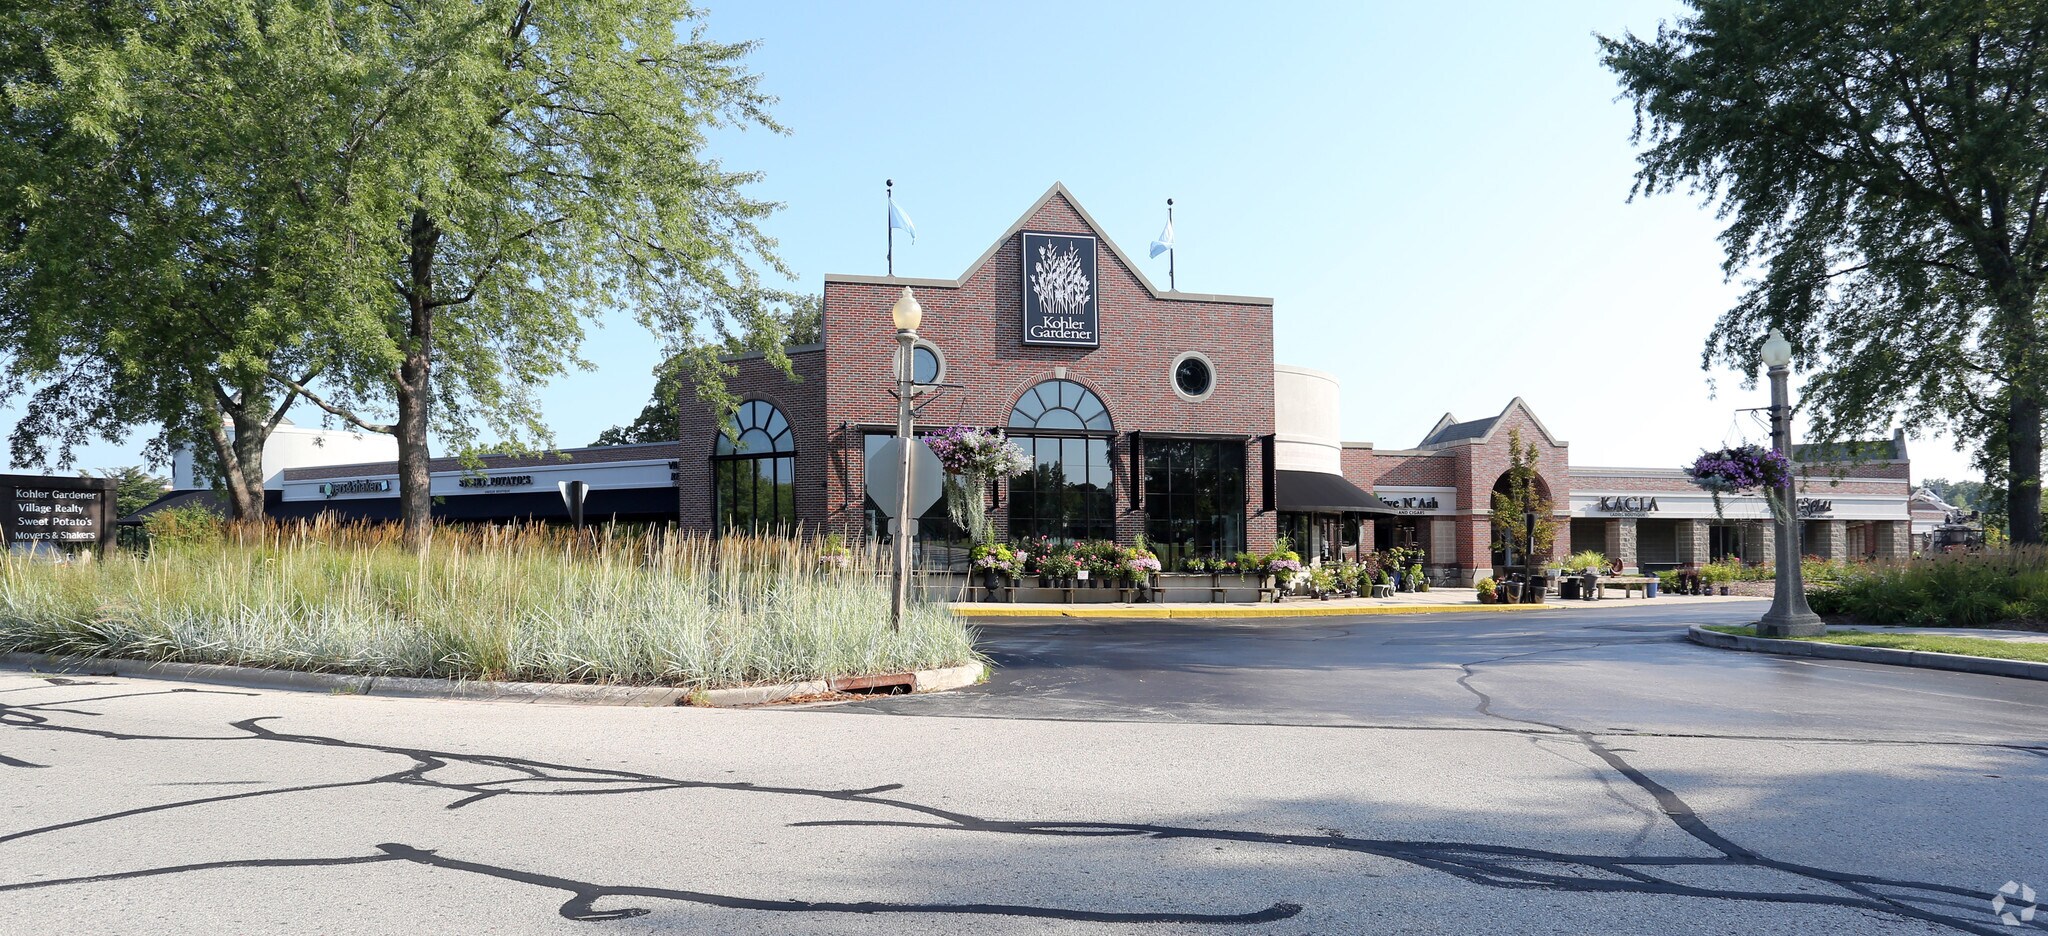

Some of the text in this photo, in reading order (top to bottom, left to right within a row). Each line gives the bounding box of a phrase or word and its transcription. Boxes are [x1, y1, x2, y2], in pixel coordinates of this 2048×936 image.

[1043, 316, 1085, 330] Kohler
[1030, 322, 1092, 340] Gardener
[490, 475, 533, 487] POTATO'S
[15, 488, 97, 501] Kohler Gardener
[1418, 496, 1439, 509] Ash
[18, 503, 84, 515] Village Realty
[18, 516, 93, 527] Sweet Potato's
[15, 531, 96, 540] Movers & Shakers
